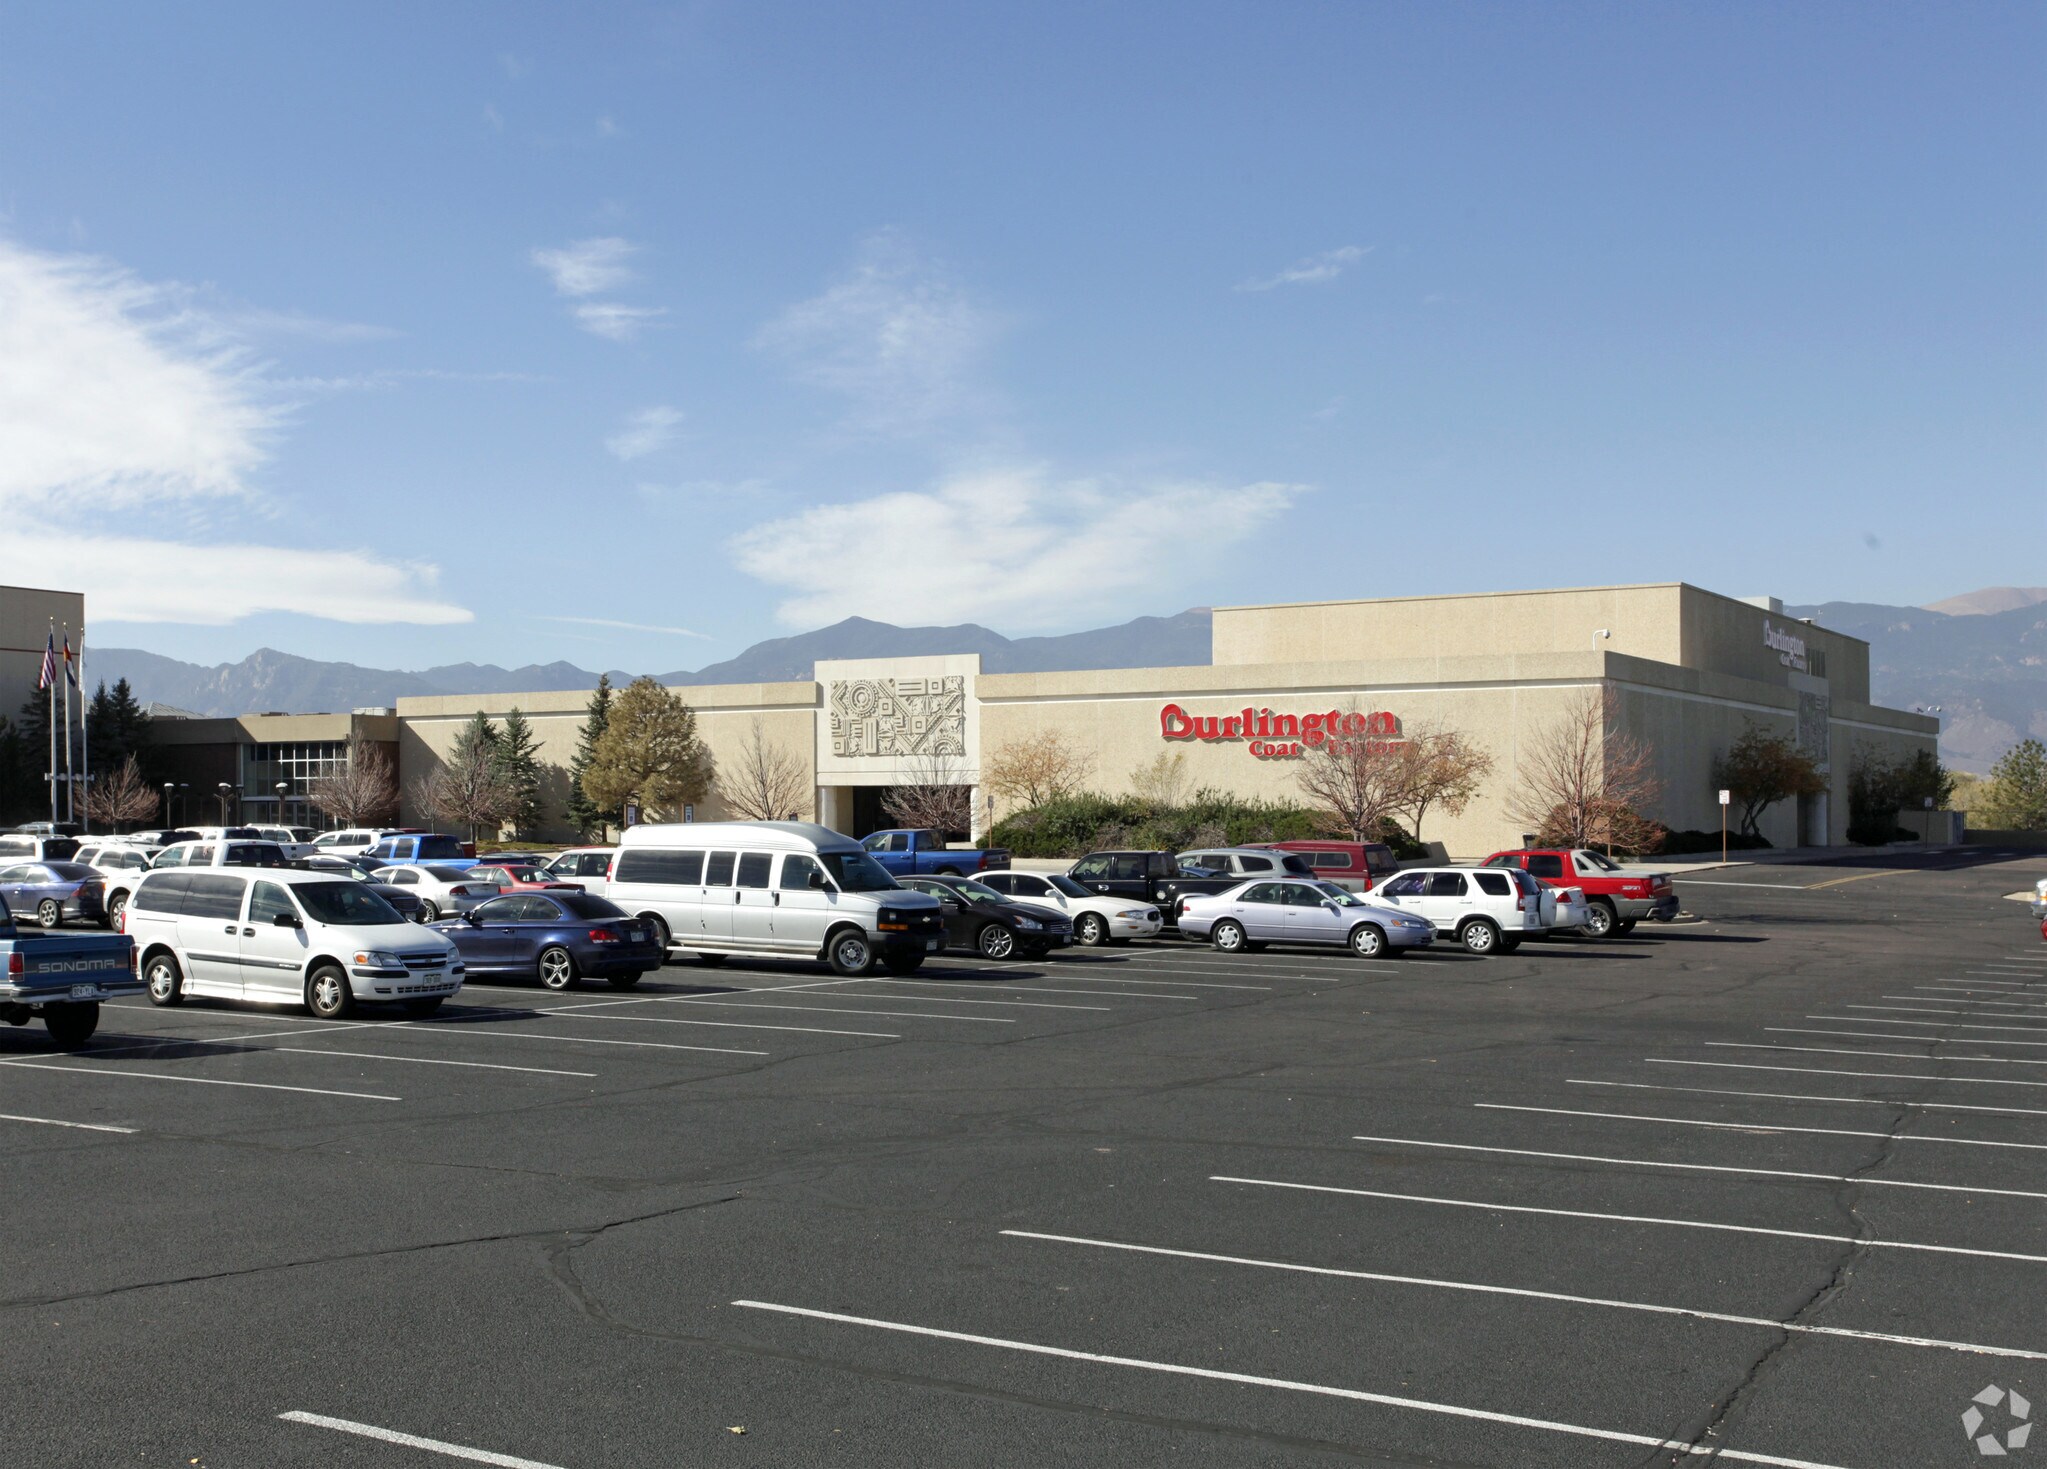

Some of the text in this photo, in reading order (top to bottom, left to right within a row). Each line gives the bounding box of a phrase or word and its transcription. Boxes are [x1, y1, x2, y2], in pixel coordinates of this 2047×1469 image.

[1160, 703, 1398, 747] Burlington
[1248, 740, 1299, 757] Coat
[38, 959, 115, 973] SONOMA
